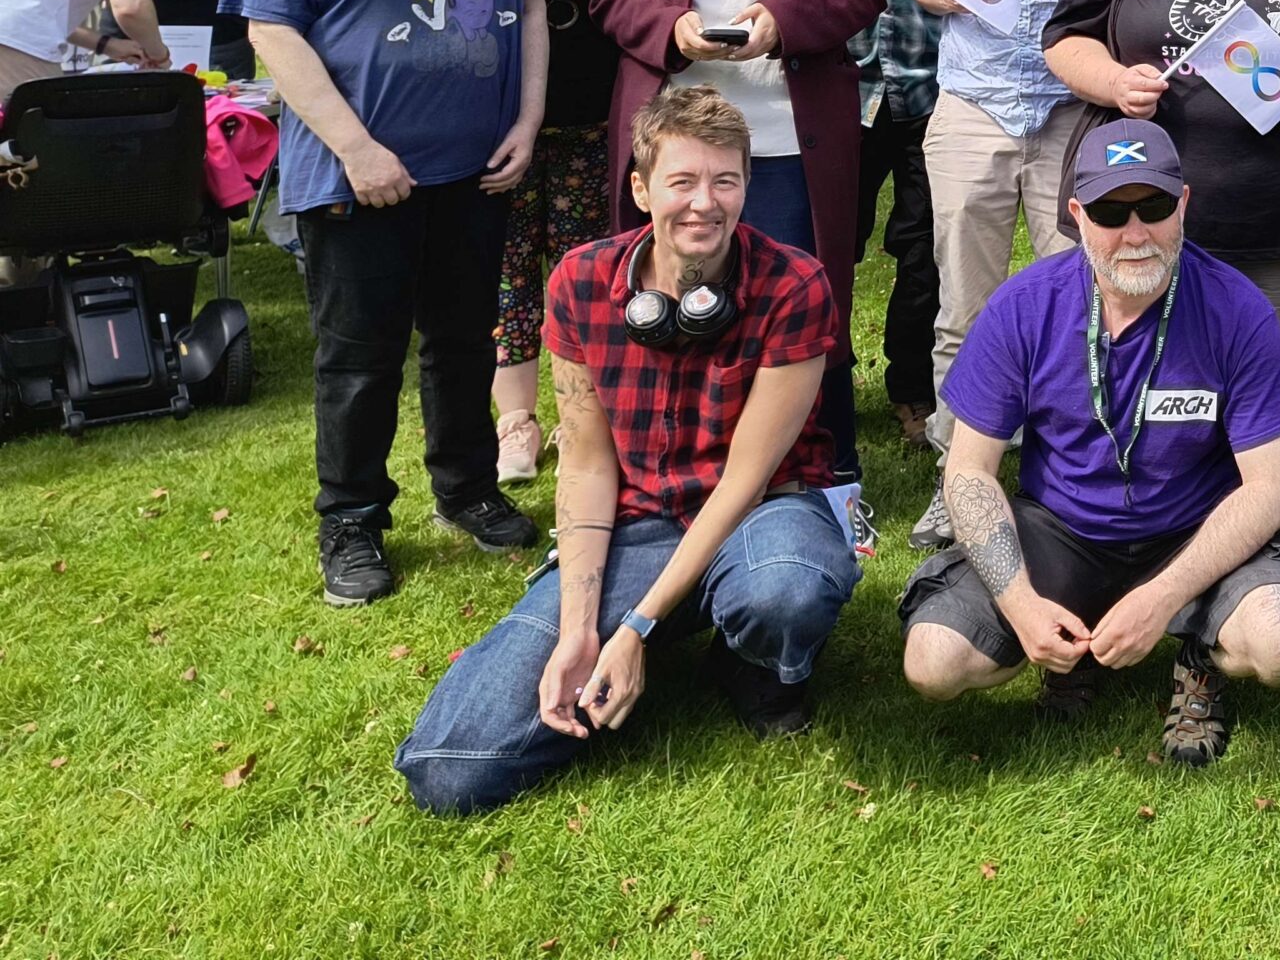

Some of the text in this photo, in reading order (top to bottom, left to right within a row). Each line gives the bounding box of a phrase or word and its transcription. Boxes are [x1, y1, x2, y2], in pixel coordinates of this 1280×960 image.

[1161, 45, 1188, 57] STA
[1163, 275, 1178, 319] VOLUNTEER
[1089, 343, 1100, 387] VOLUNTEER
